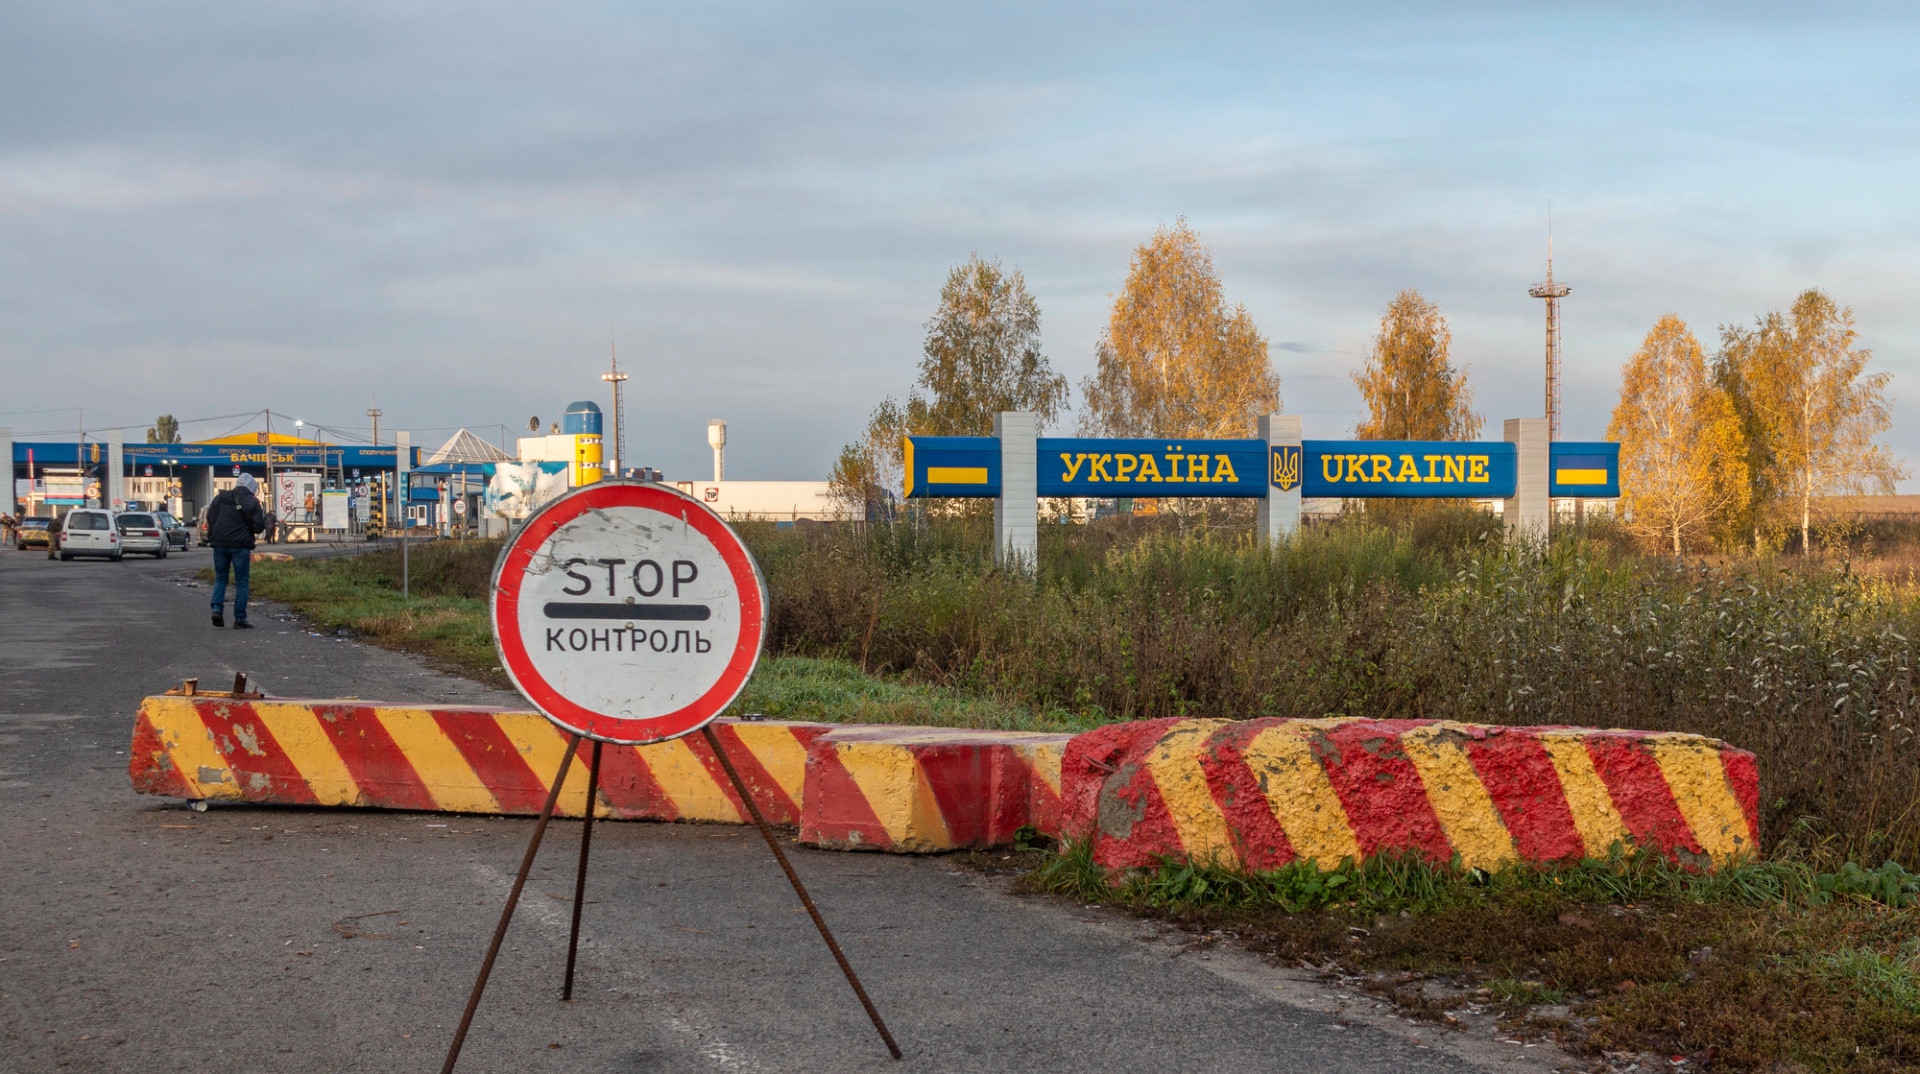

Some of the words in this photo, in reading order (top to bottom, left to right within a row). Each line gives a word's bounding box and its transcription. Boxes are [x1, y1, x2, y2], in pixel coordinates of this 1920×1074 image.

[231, 453, 294, 462] БАЧІВСЬК
[1060, 445, 1239, 482] УКРАЇНА
[1321, 455, 1489, 482] UKRAINE
[562, 558, 698, 598] STOP
[546, 627, 712, 653] КОНТРОЛЬ
